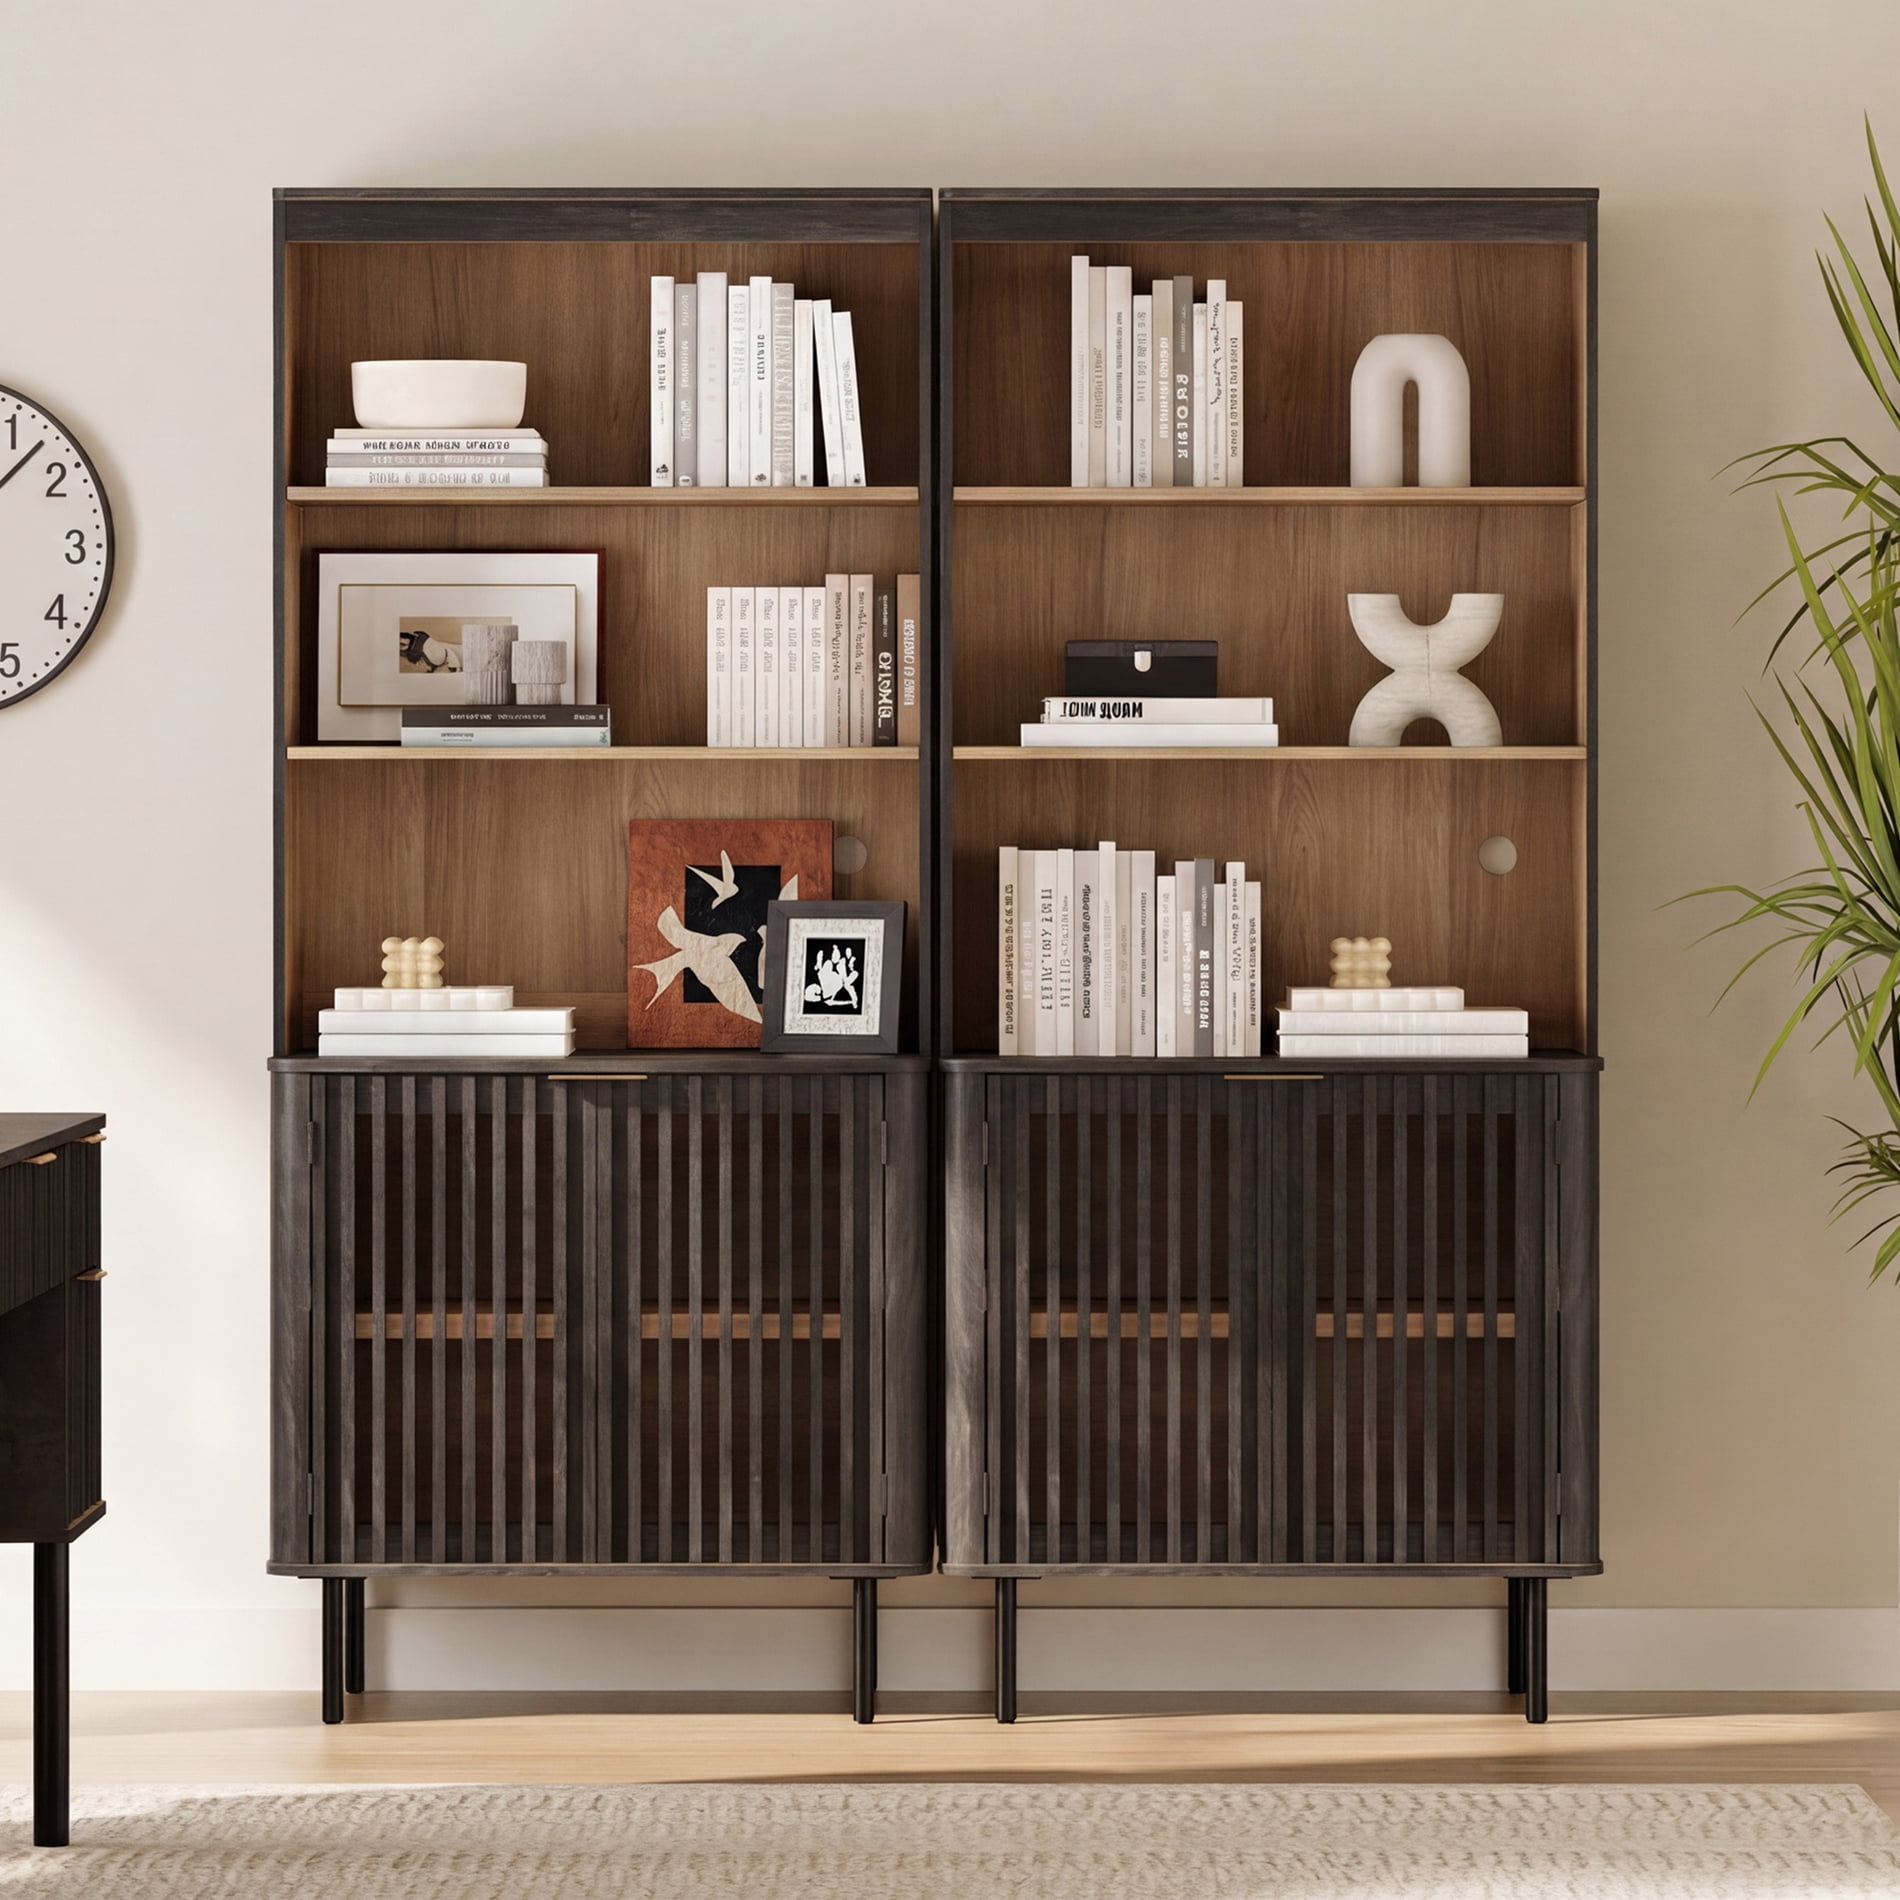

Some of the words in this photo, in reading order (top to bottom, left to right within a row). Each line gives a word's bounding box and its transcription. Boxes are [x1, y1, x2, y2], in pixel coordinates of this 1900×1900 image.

[5, 414, 17, 450] 1
[45, 462, 67, 498] 2
[64, 530, 86, 565] 3
[44, 594, 68, 630] 4
[0, 642, 21, 678] 5
